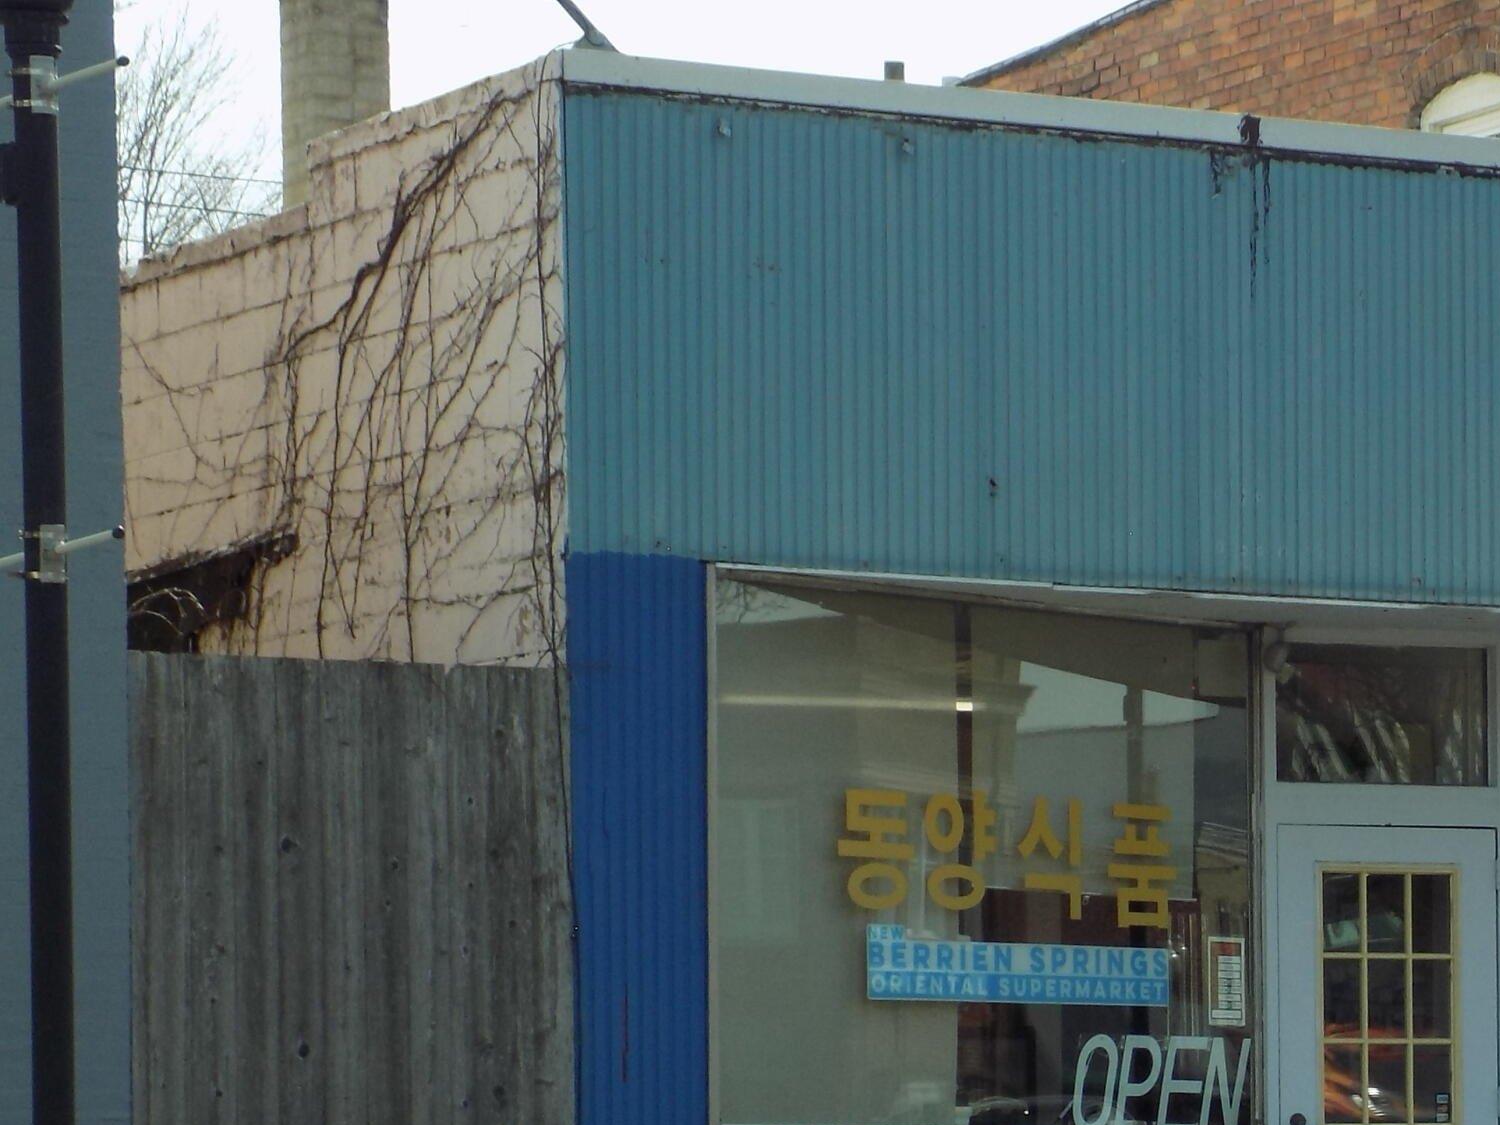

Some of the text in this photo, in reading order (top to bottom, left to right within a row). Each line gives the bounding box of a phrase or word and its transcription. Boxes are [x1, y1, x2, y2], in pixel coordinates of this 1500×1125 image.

[869, 926, 904, 939] NEW
[869, 941, 1168, 977] BERRIEN SPRINGS
[871, 974, 1165, 1001] ORIENTAL SUPERMARKET
